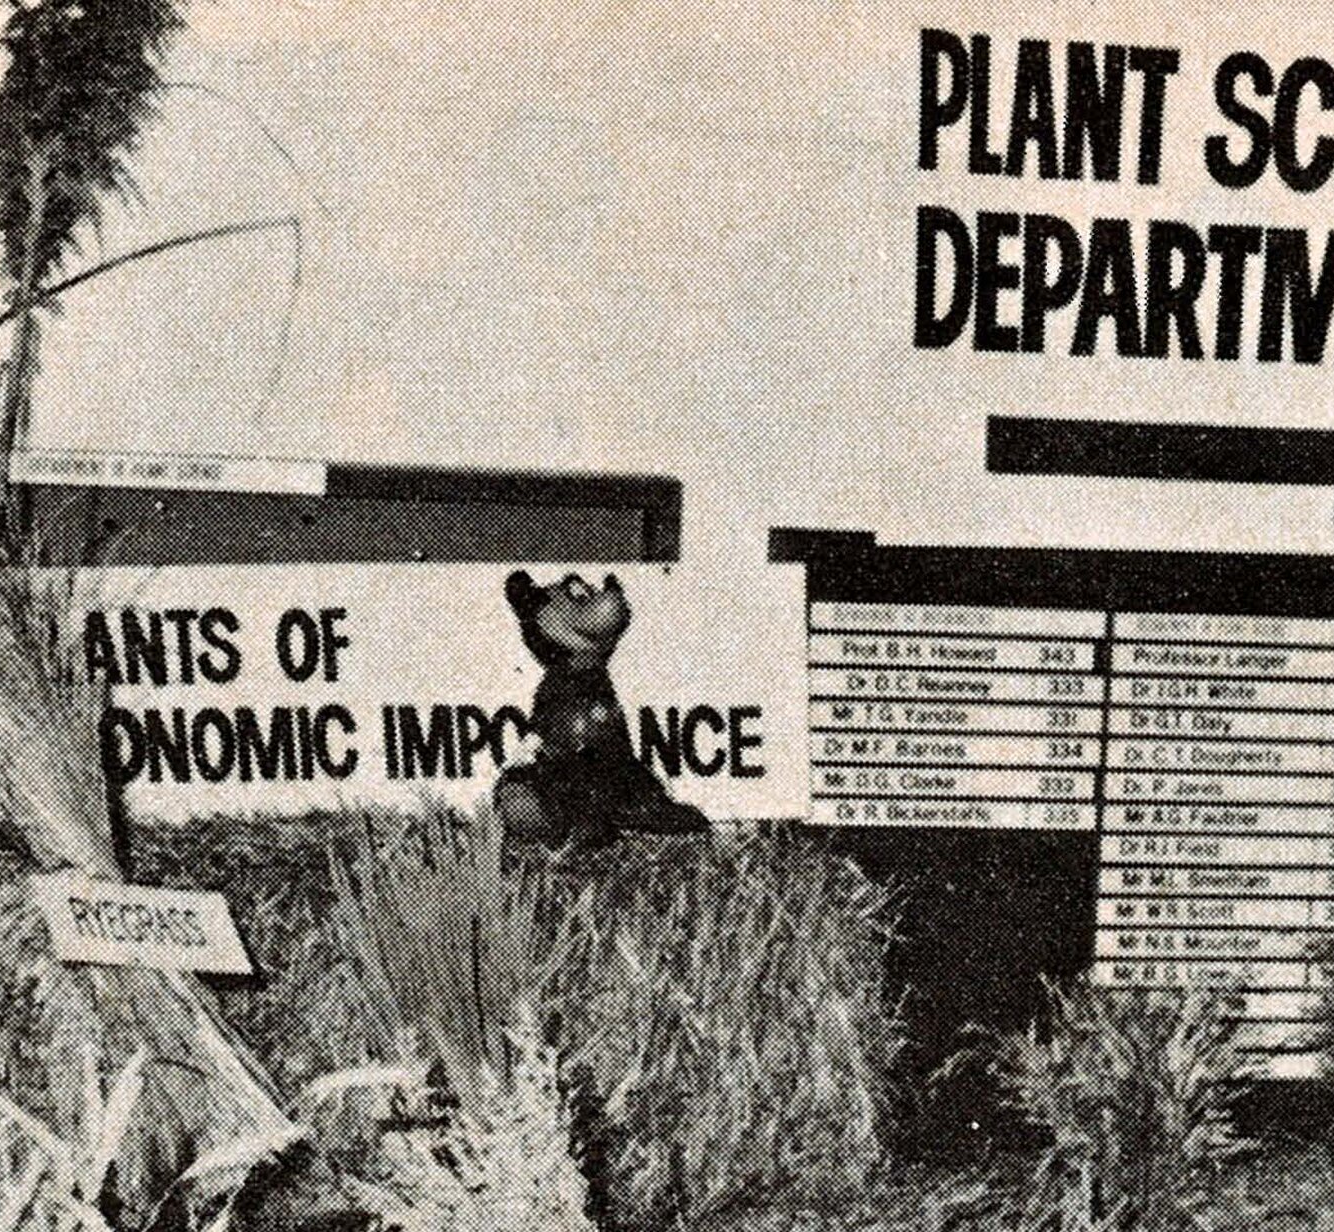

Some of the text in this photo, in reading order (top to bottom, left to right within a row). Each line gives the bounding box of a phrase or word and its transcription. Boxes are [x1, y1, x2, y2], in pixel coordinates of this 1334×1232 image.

[917, 27, 1180, 185] PLANT
[83, 605, 350, 687] ANTS OF
[930, 644, 996, 662] Howard
[1131, 648, 1219, 667] Professor
[1225, 652, 1288, 671] Langer
[1207, 683, 1257, 701] White
[98, 704, 766, 783] ONOMIC IMPONCE
[895, 739, 966, 759] Barnes
